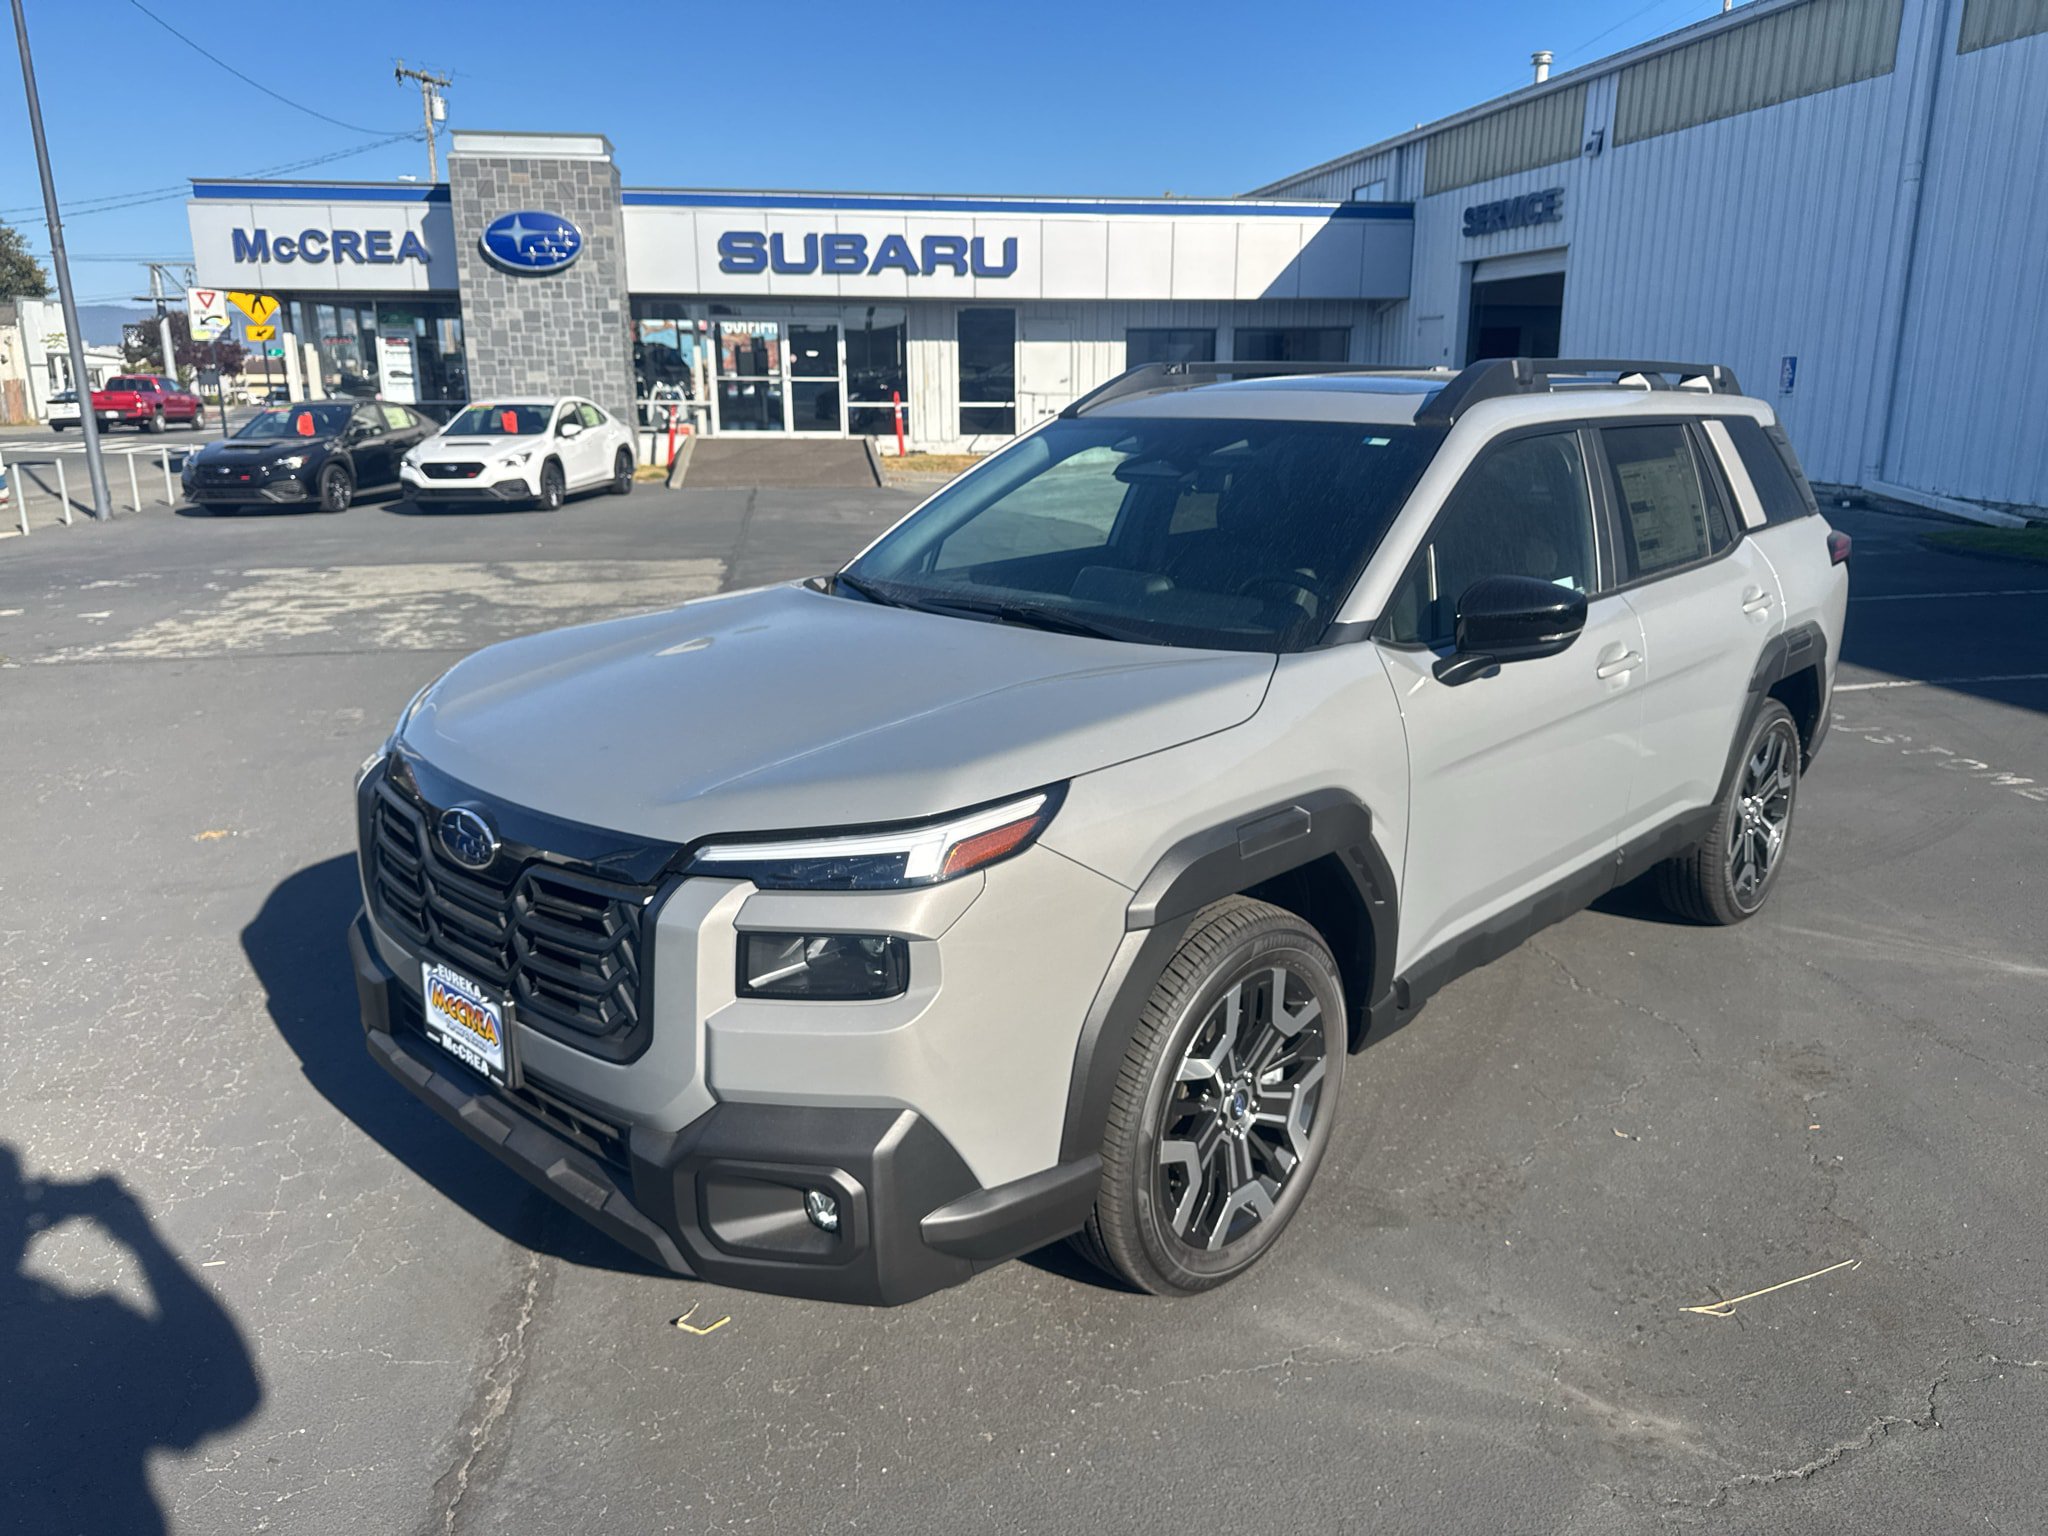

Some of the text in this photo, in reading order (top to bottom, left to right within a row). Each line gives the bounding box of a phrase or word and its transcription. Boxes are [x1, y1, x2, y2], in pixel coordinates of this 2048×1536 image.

[1462, 187, 1565, 237] SERVICE
[232, 227, 431, 264] McCREA
[718, 231, 1018, 278] SUBARU
[437, 963, 481, 998] EUREKA
[442, 1033, 489, 1076] McCREA
